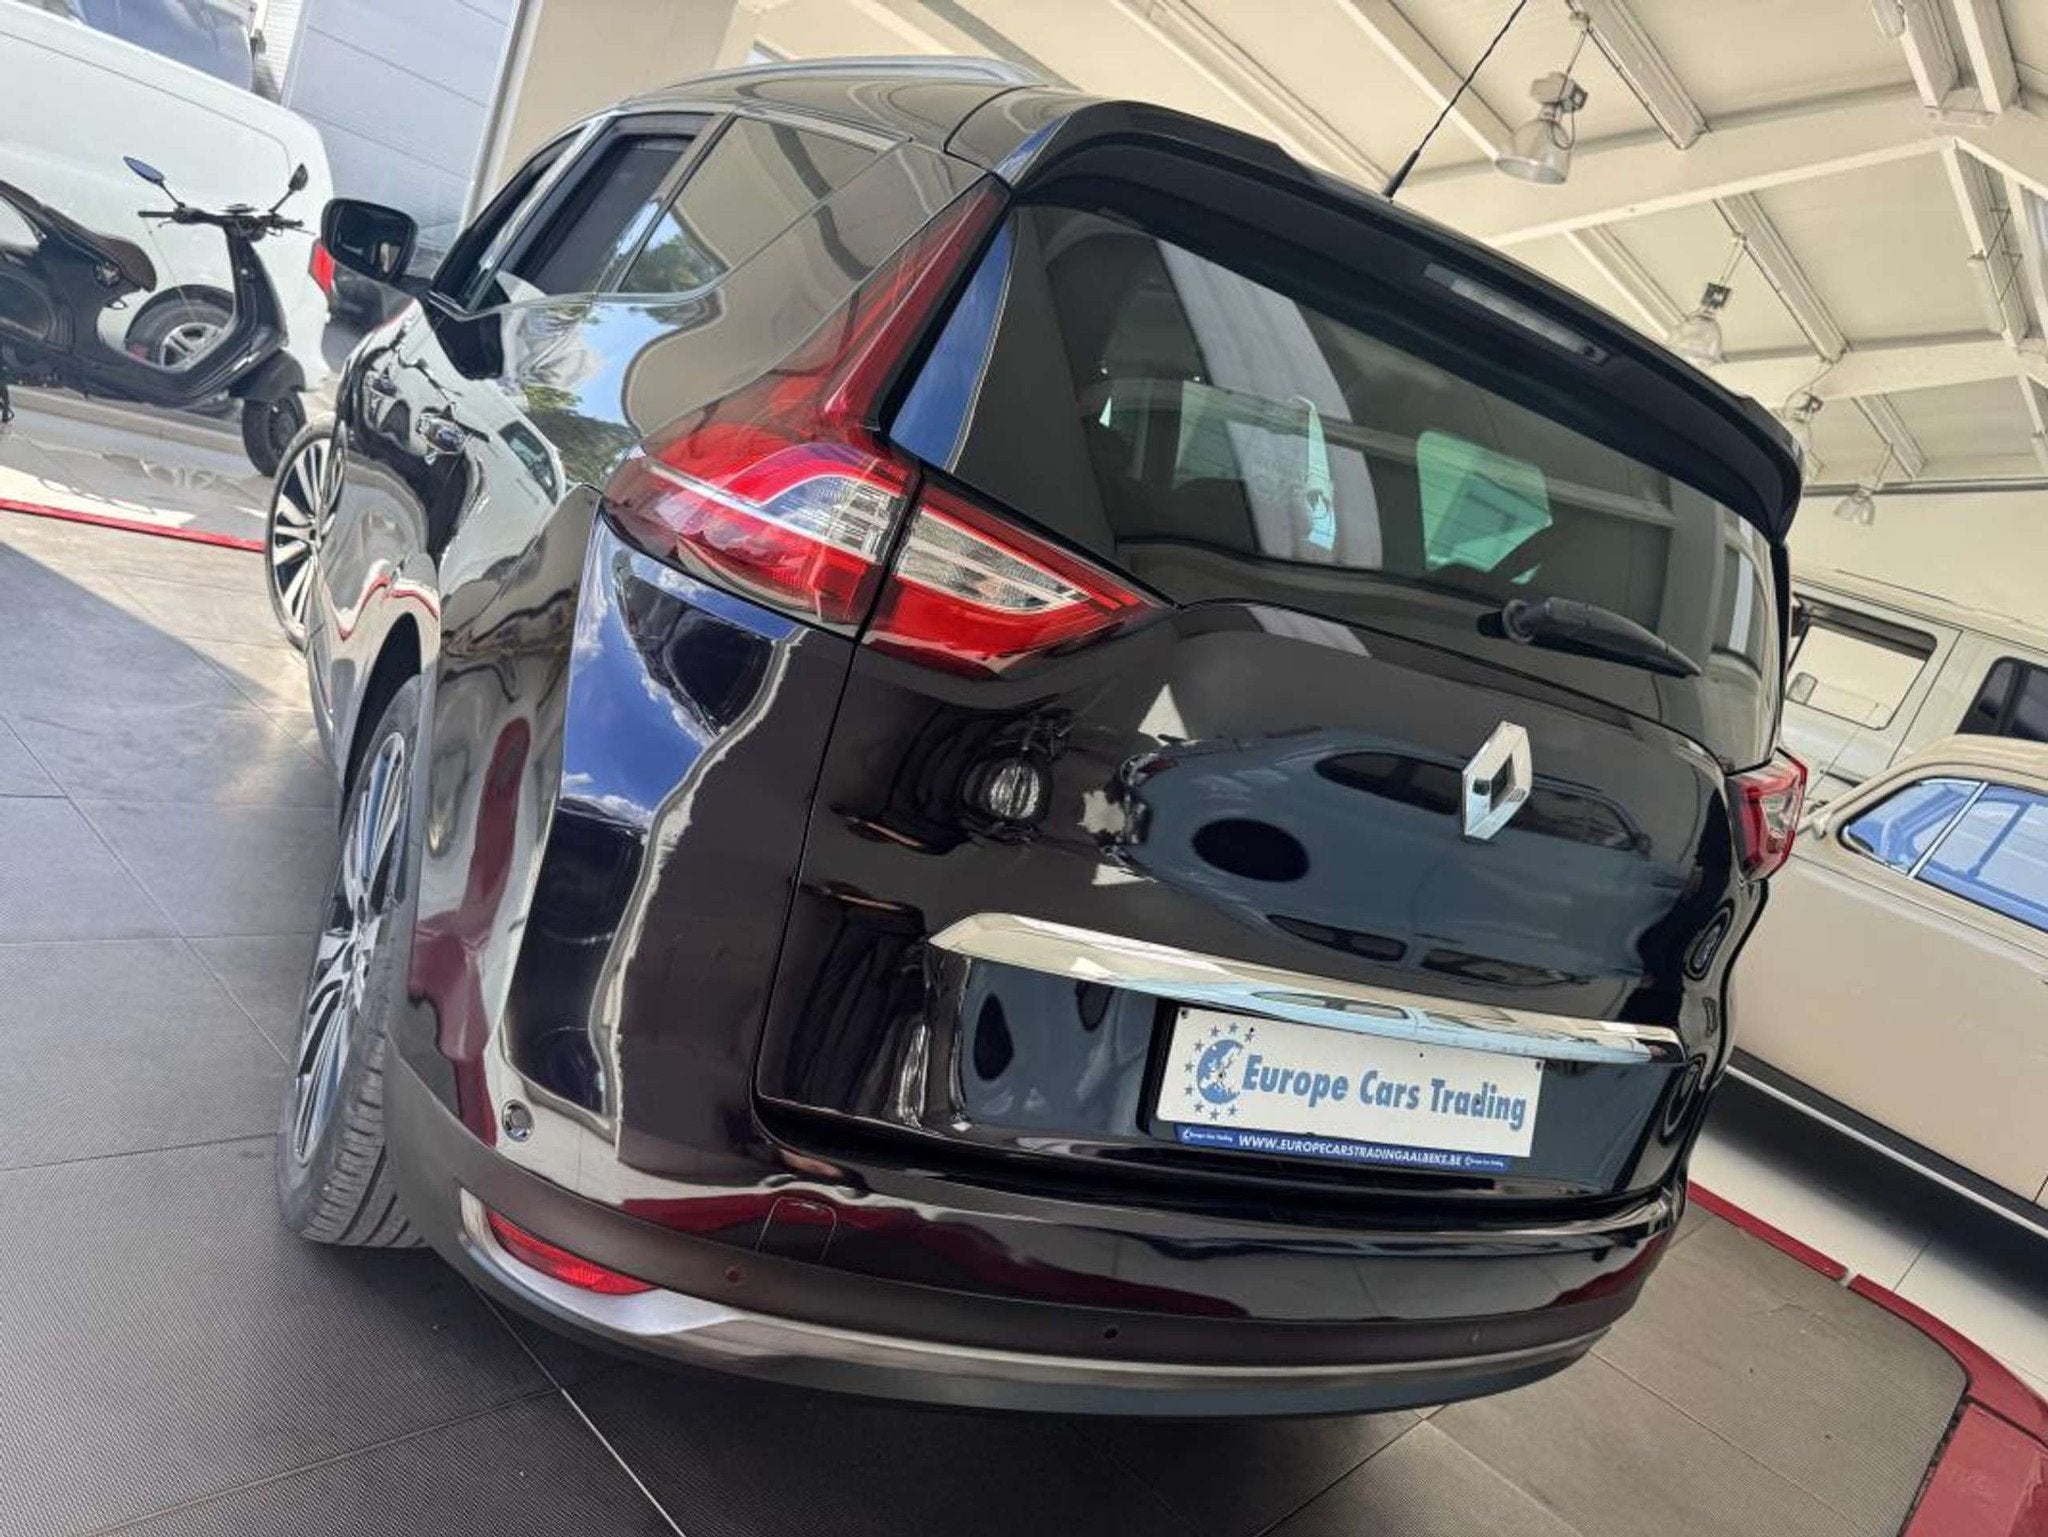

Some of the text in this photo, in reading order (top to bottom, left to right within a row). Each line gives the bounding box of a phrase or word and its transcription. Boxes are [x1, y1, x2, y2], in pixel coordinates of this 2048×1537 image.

[1242, 1054, 1526, 1131] Europe Cars Trading
